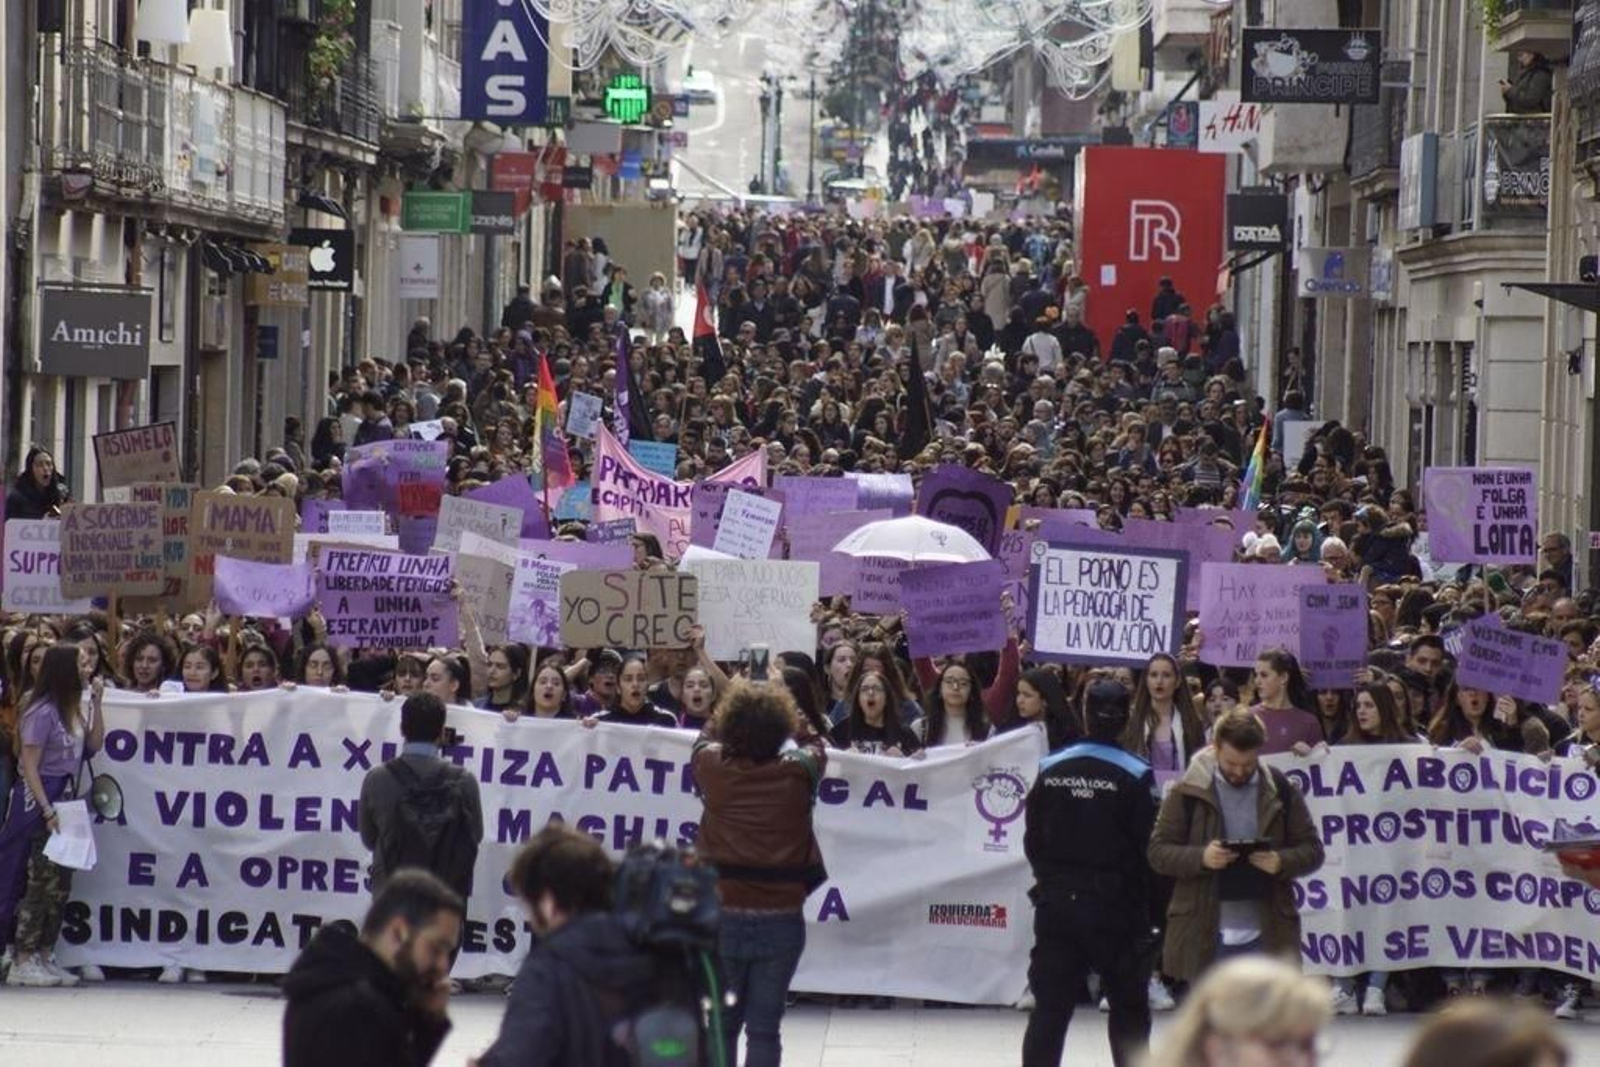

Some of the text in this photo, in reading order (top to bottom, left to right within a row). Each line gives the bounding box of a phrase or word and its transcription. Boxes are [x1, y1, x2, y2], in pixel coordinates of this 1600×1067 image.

[1502, 172, 1550, 196] PRINC
[50, 320, 141, 345] Amichi
[600, 456, 693, 508] PATRIAR
[1482, 487, 1526, 506] FOLGA
[1493, 505, 1527, 519] UNHA
[1474, 523, 1533, 556] LOITA
[10, 549, 60, 575] SUPP
[327, 550, 449, 576] PREFIRO UNHA
[1046, 557, 1160, 591] EL PORNO ES
[11, 585, 76, 606] GIRL
[396, 576, 452, 593] PERIGOS
[337, 596, 422, 614] A UNHA
[564, 596, 601, 626] YO
[1044, 590, 1060, 616] LA
[1131, 594, 1154, 622] DE
[326, 615, 440, 635] ESCRAVITUDE
[1066, 622, 1082, 648] LA
[105, 729, 270, 768] ONTRA
[288, 733, 322, 768] A
[1284, 761, 1366, 797] OLA
[1071, 788, 1095, 799] VIGO
[155, 790, 361, 832] VIOLEN
[127, 852, 157, 886] E
[176, 852, 209, 887] A
[1341, 866, 1477, 910] NOSOS
[929, 904, 992, 918] IZQUIERDA
[929, 913, 1007, 929] REVOLUCIONARIA
[61, 900, 358, 949] SINDICAT
[1383, 924, 1430, 961] SE
